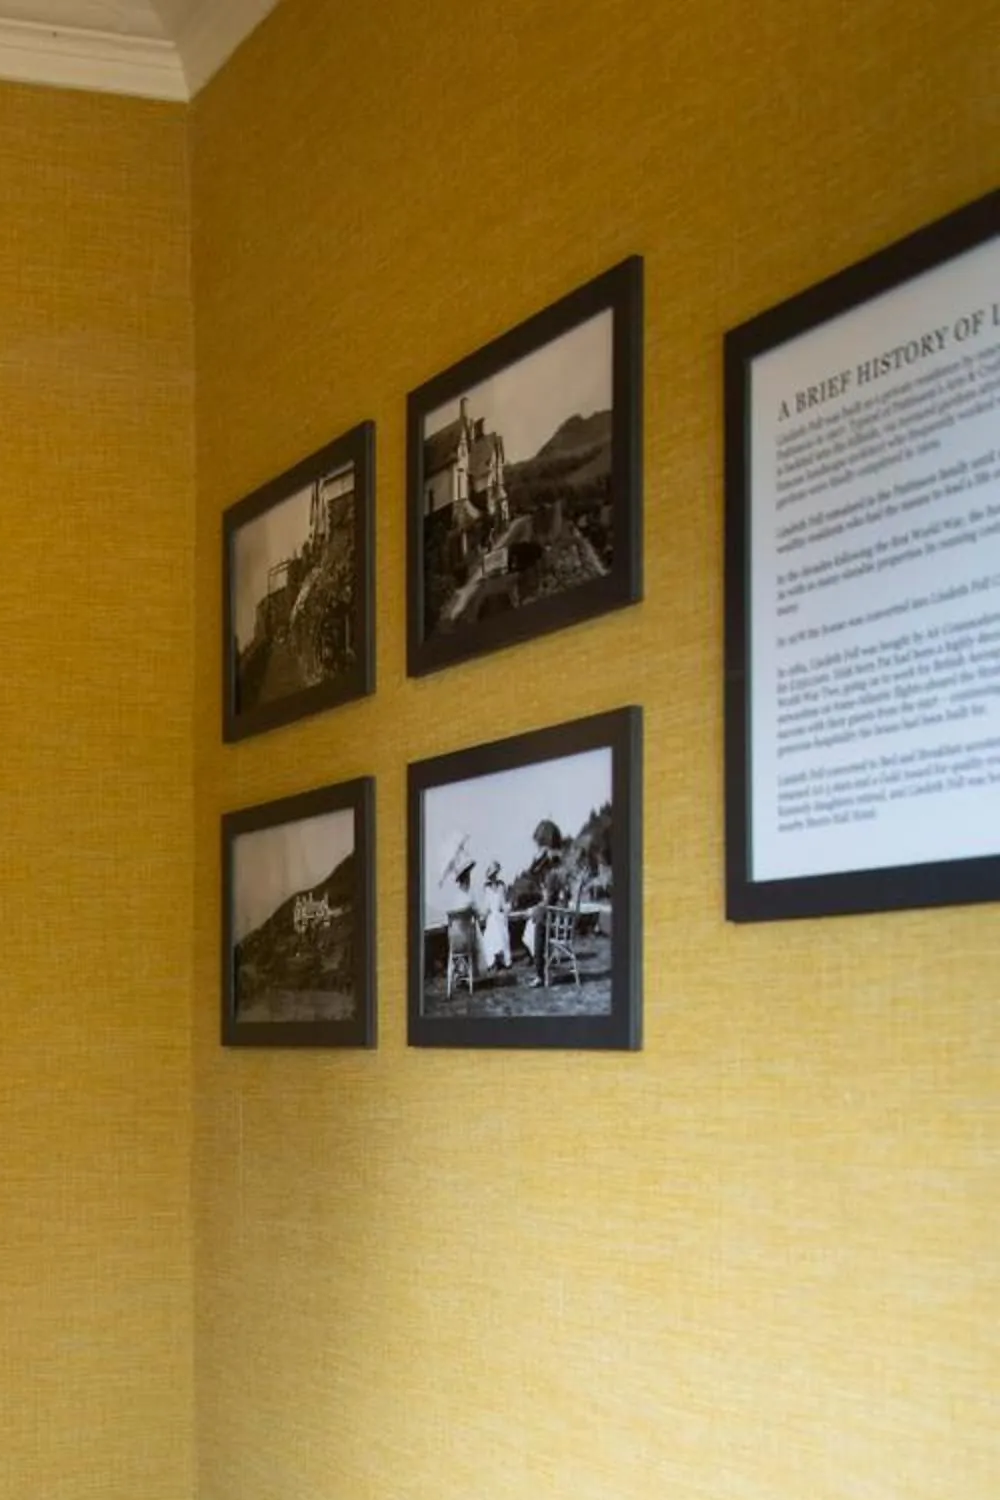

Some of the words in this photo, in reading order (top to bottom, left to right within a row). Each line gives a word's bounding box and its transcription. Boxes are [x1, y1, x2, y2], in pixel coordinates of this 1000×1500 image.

[777, 399, 790, 422] A
[795, 370, 851, 414] BRIEF
[857, 326, 949, 386] HISTORY
[953, 309, 985, 342] OF
